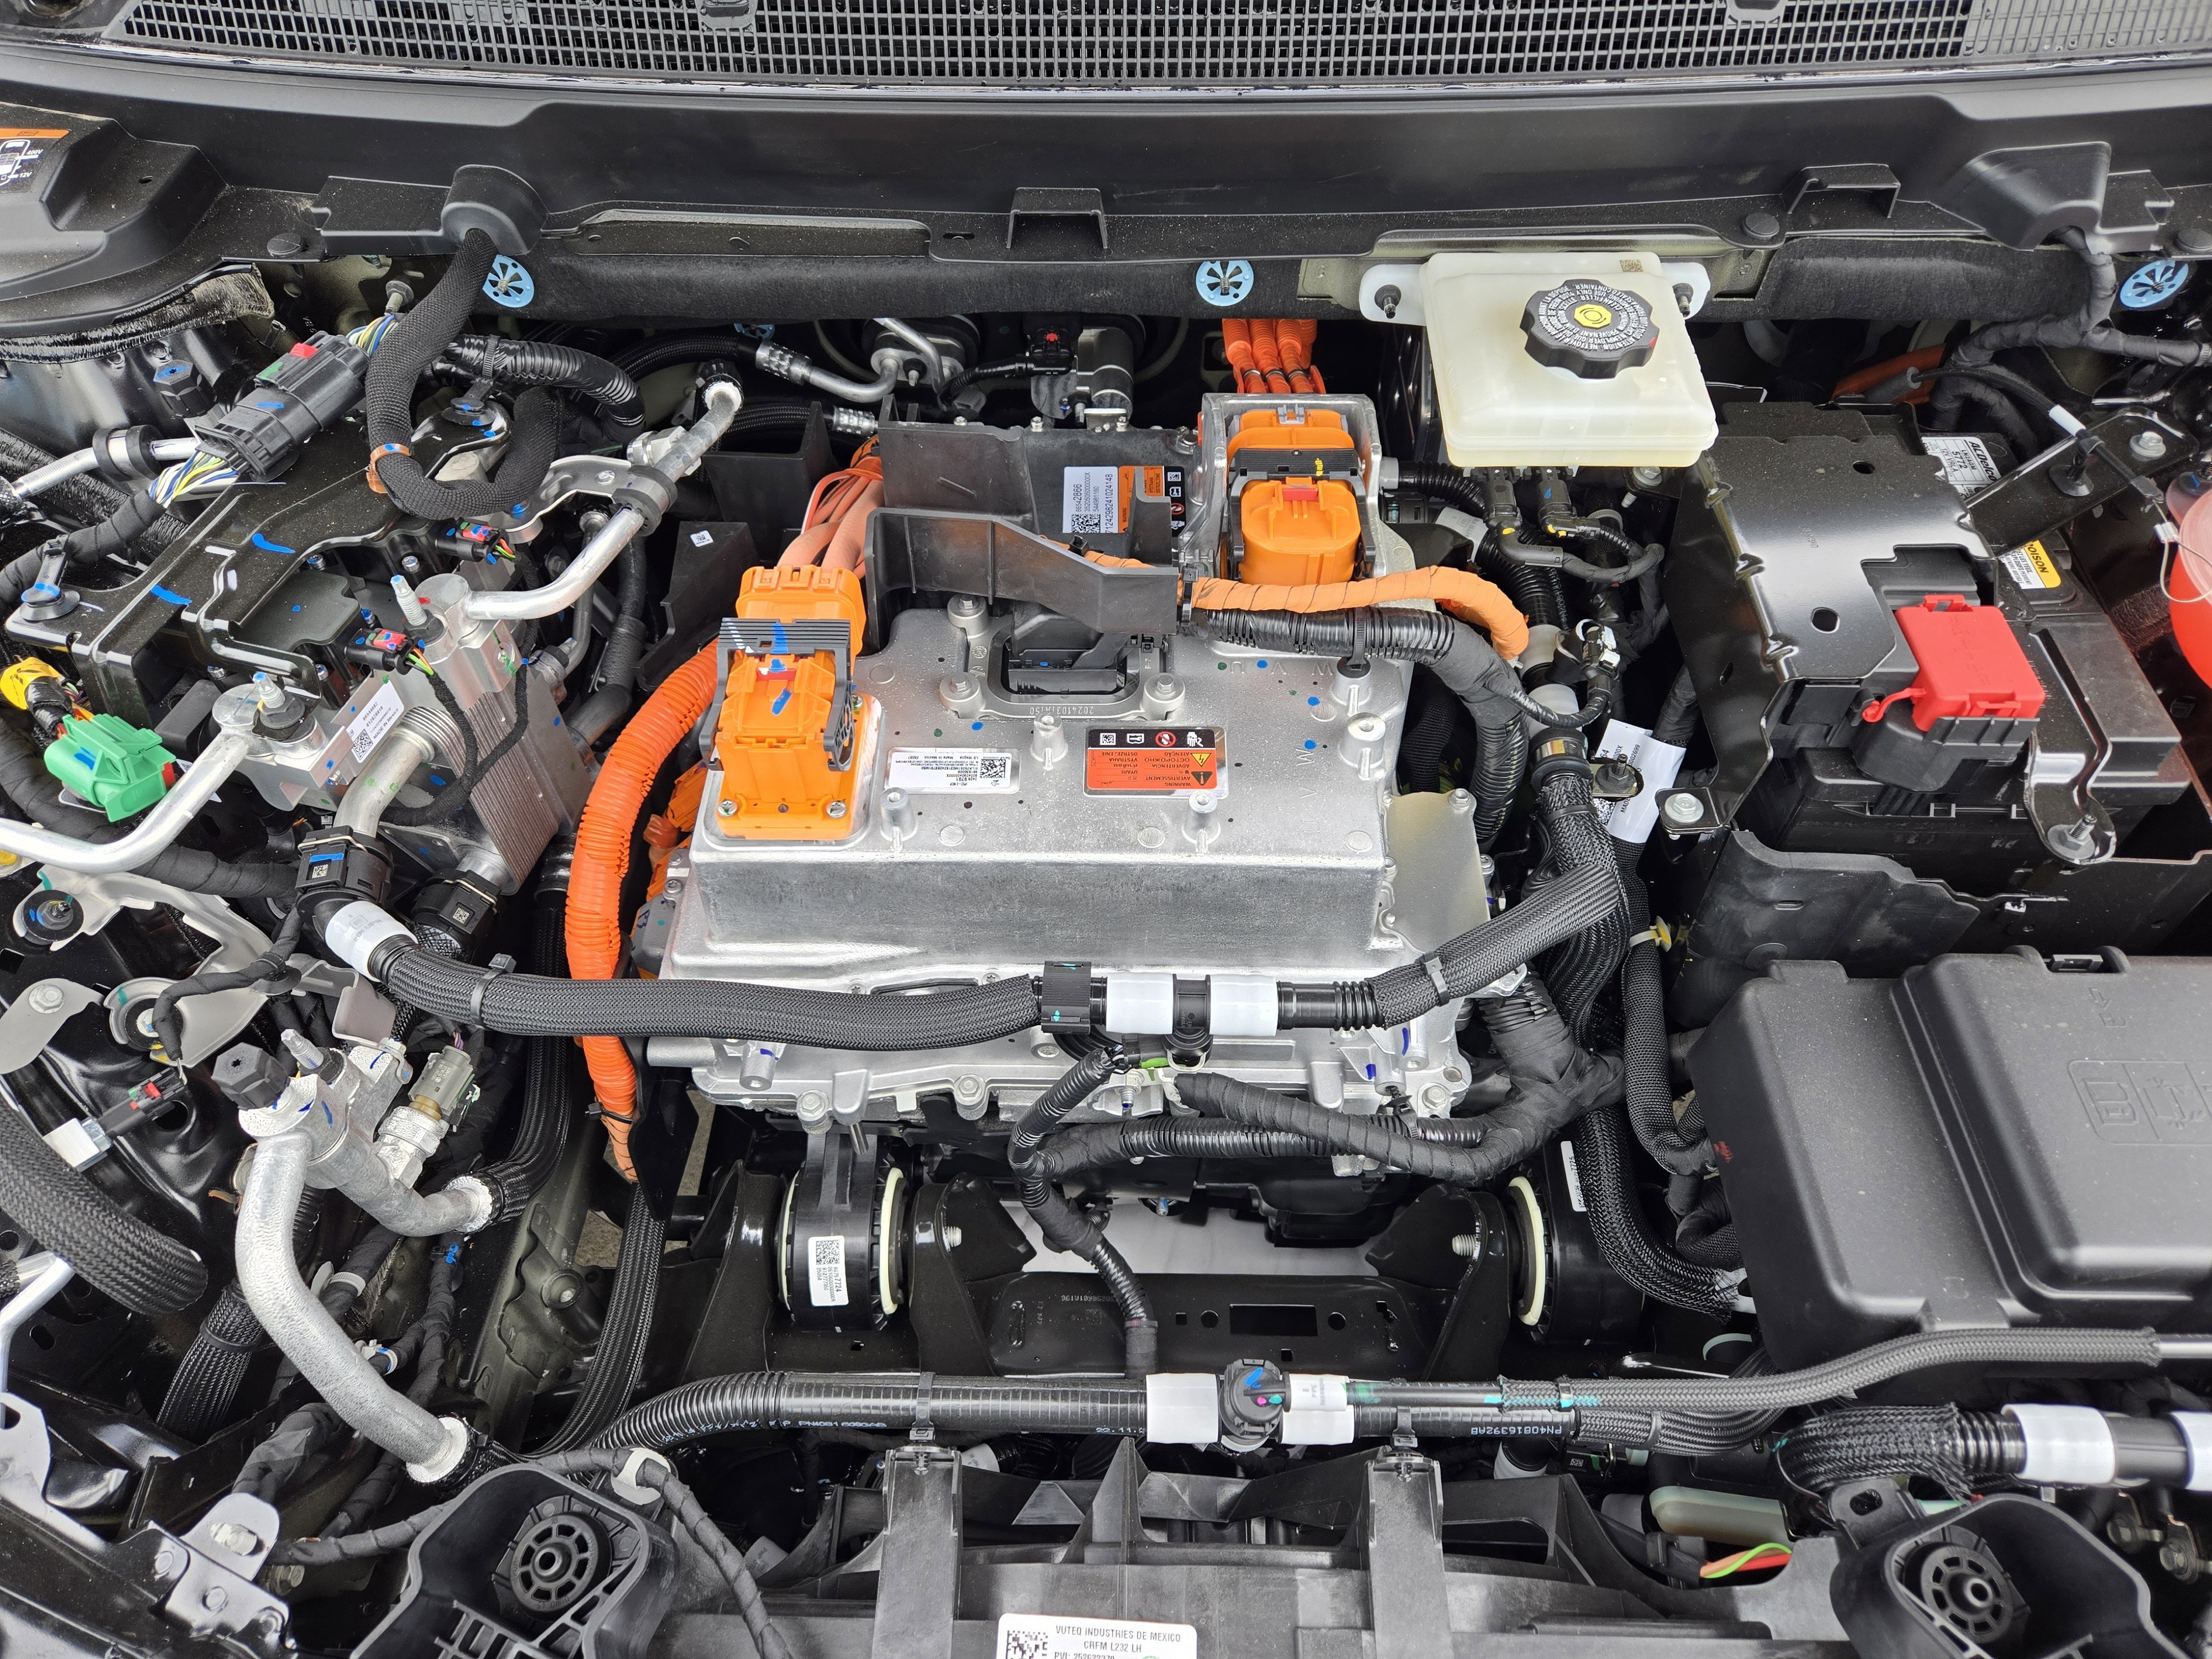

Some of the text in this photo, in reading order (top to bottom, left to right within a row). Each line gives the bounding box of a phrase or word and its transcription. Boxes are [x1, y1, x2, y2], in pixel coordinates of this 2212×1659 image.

[1952, 451, 1968, 469] 5772
[1056, 1625, 1181, 1642] VUTEQ INDUSTRIES DE MEXICO
[1084, 1641, 1141, 1653] CRFM L232 LH
